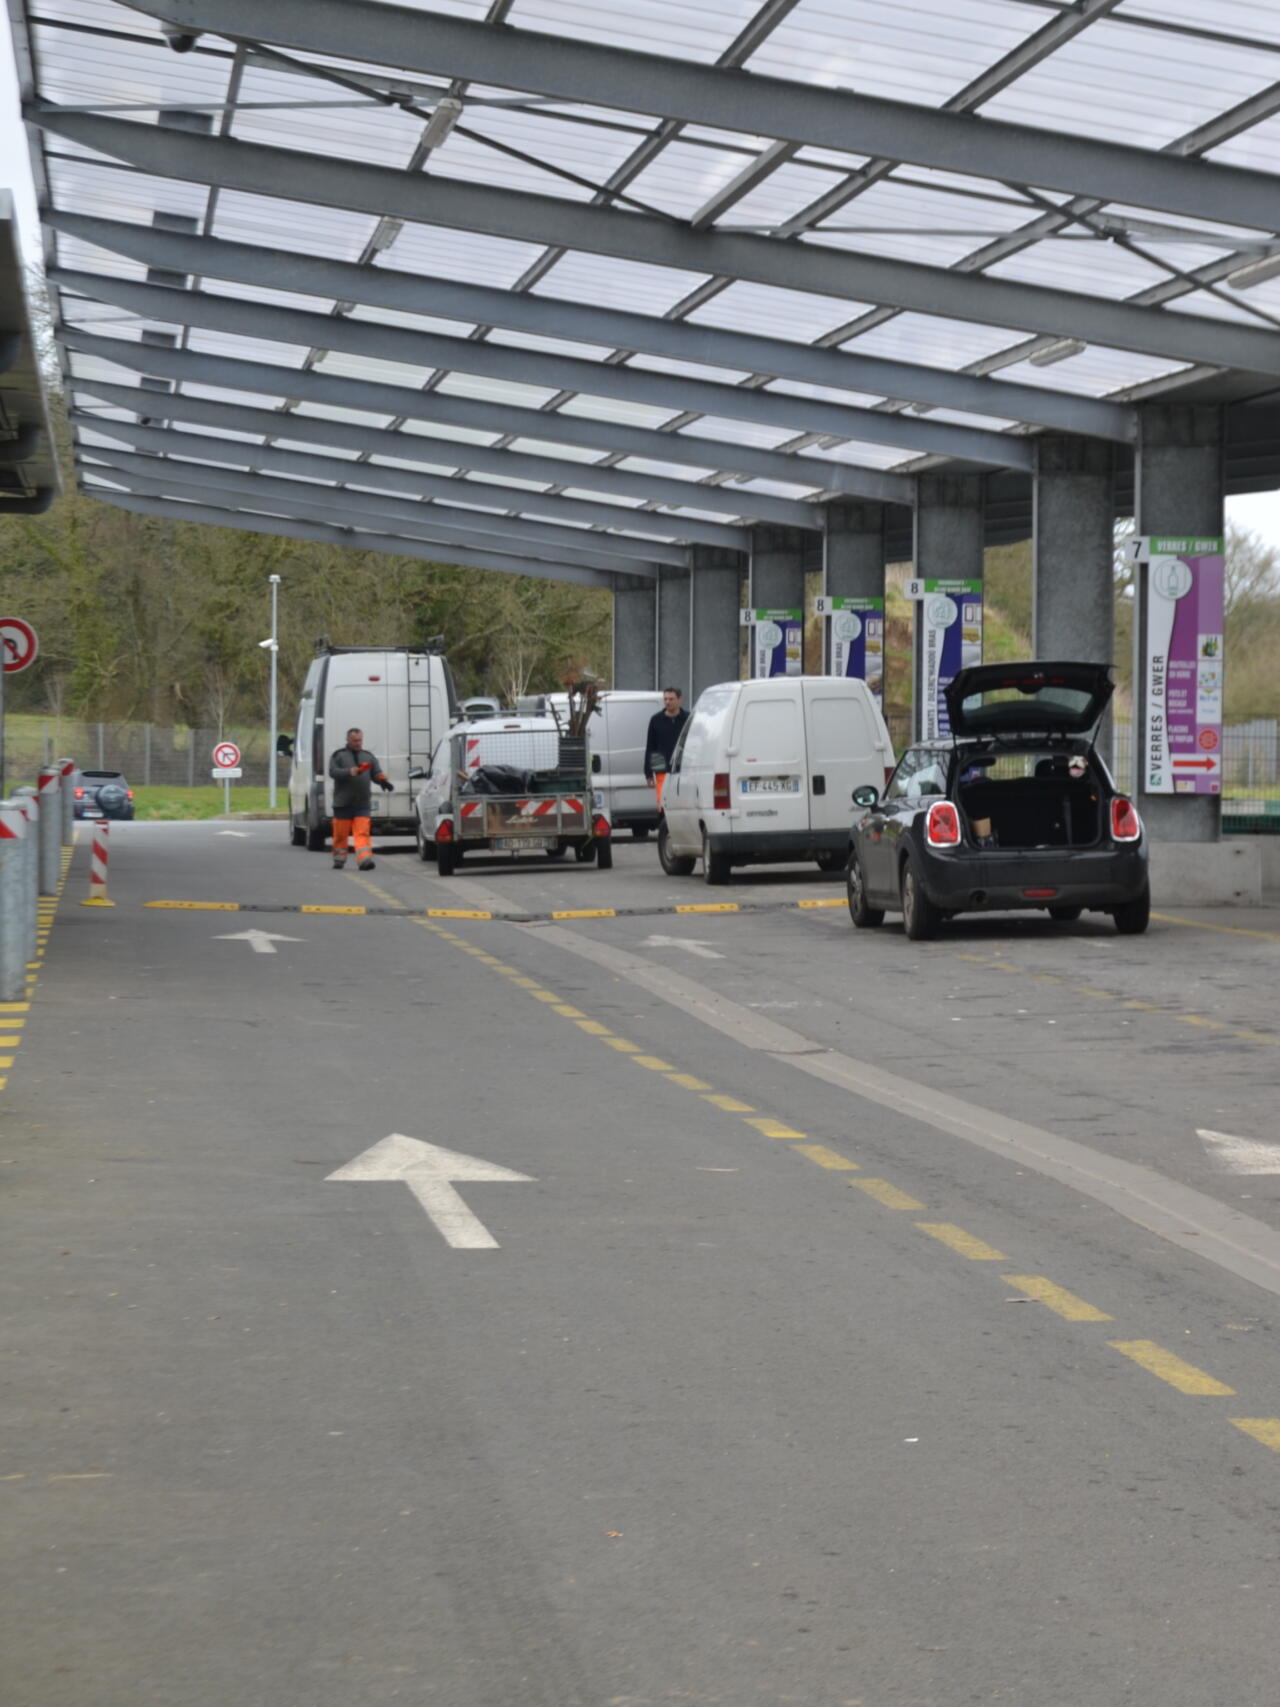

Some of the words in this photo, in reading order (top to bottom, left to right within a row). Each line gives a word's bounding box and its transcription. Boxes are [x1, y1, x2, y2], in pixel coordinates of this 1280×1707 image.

[1132, 540, 1142, 559] 7
[1157, 541, 1187, 552] VERRES
[911, 582, 919, 594] 8
[816, 599, 824, 612] 8
[744, 610, 751, 622] 8
[1152, 655, 1164, 696] GWER
[1150, 715, 1163, 771] VERRES
